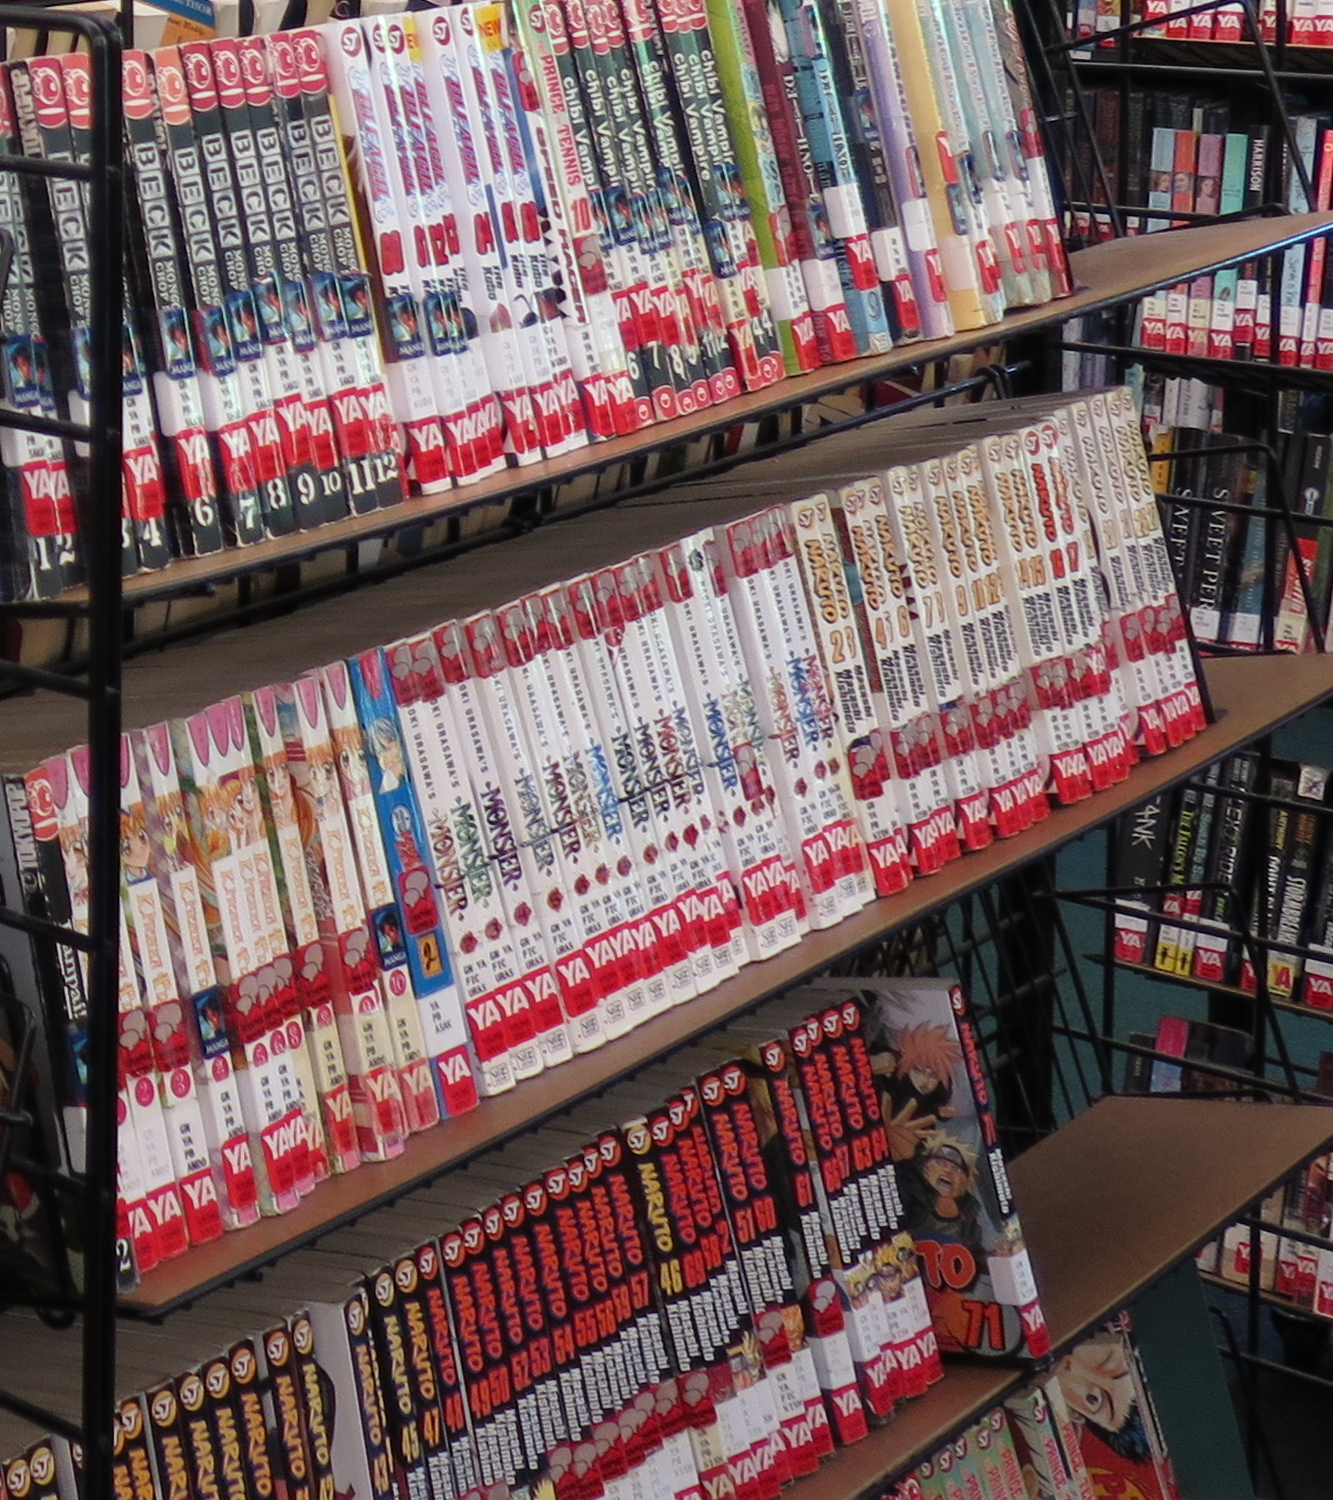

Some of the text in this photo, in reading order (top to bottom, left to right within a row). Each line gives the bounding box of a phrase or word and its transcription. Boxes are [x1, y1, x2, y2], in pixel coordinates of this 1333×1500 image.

[559, 125, 582, 187] TENNIS
[685, 100, 712, 182] Vampire
[134, 142, 175, 257] BECK
[203, 133, 242, 249] BECK
[713, 1112, 749, 1202] NARUTO
[637, 1162, 683, 1295] NARUTO 46
[961, 1300, 1005, 1351] 71
[1022, 1306, 1044, 1331] YA
